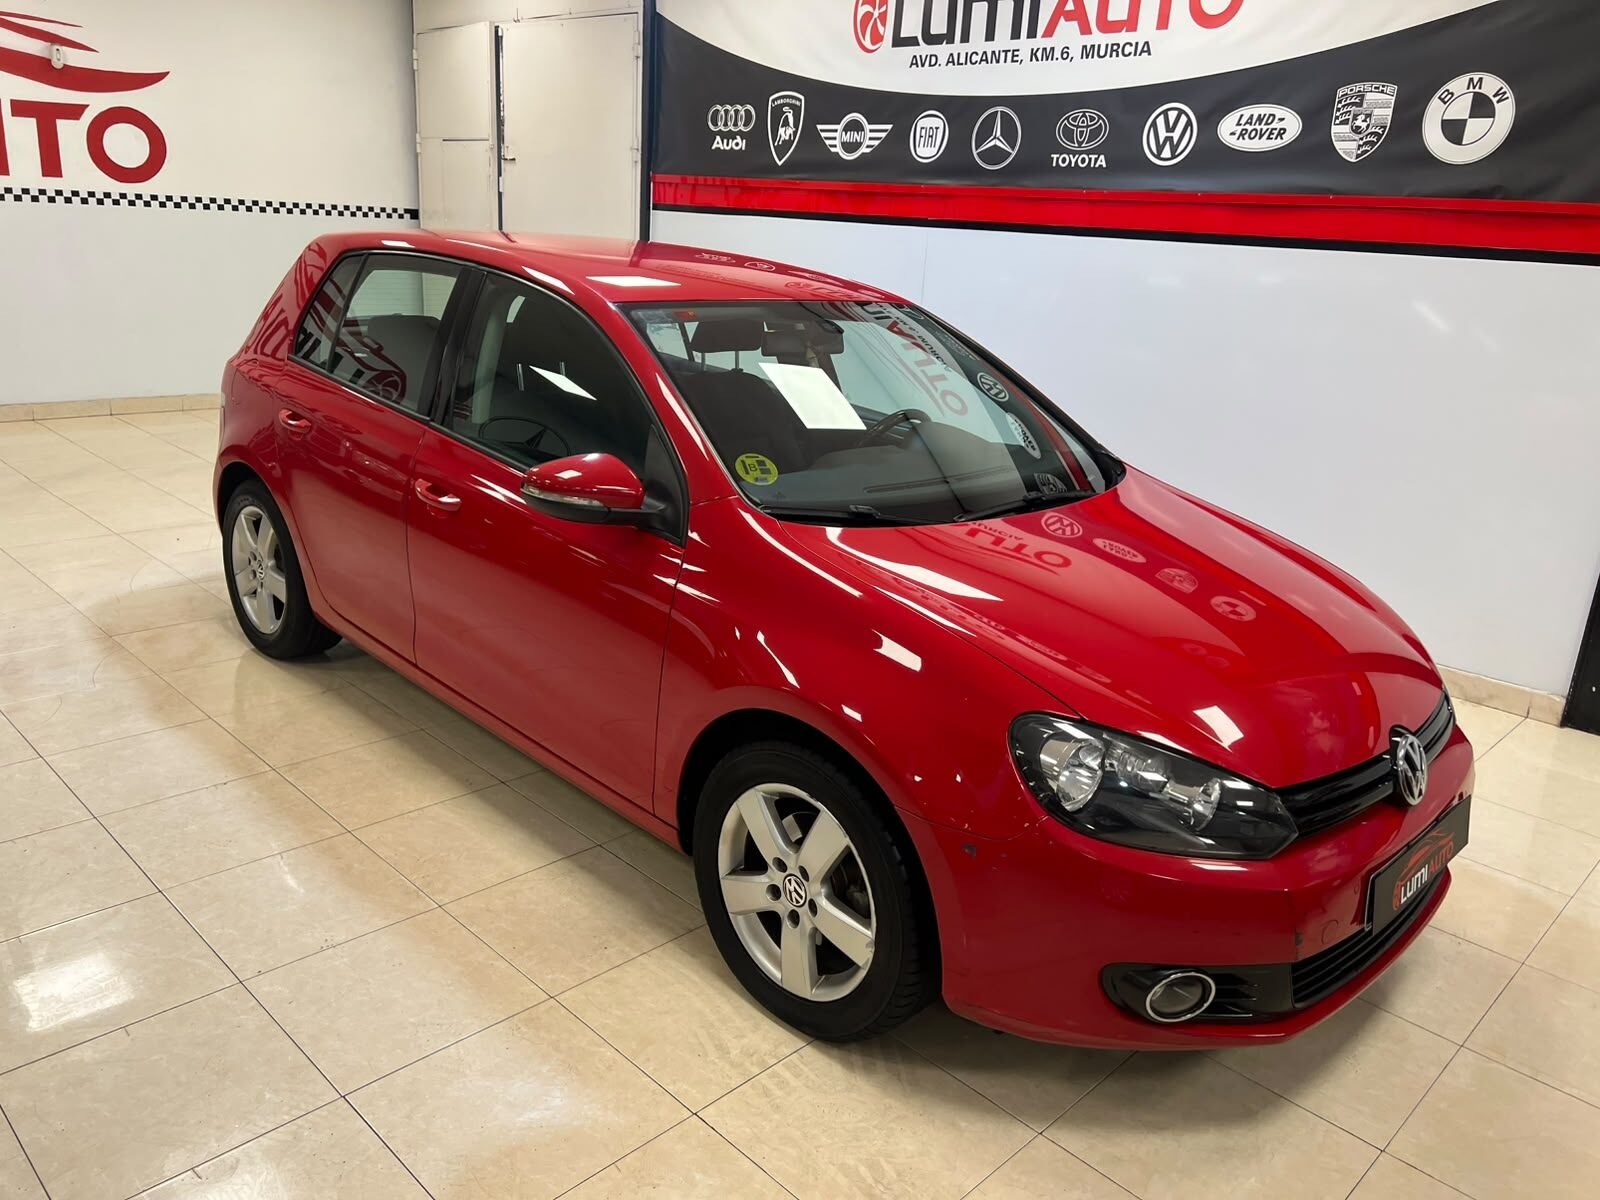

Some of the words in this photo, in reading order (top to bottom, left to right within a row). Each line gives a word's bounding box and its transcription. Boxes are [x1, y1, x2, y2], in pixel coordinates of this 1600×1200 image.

[909, 53, 941, 68] AVD.
[945, 49, 1024, 66] ALICANTE,
[1029, 45, 1074, 63] KM.6,
[1080, 41, 1152, 60] MURCIA
[1338, 84, 1395, 97] PORSCHE
[1438, 77, 1509, 105] BMW
[1235, 113, 1276, 127] LAND
[841, 130, 865, 143] MINI
[918, 126, 940, 148] FIAT
[1236, 127, 1287, 141] ROVER
[711, 135, 746, 151] Audi
[1051, 154, 1107, 168] TOYOTA
